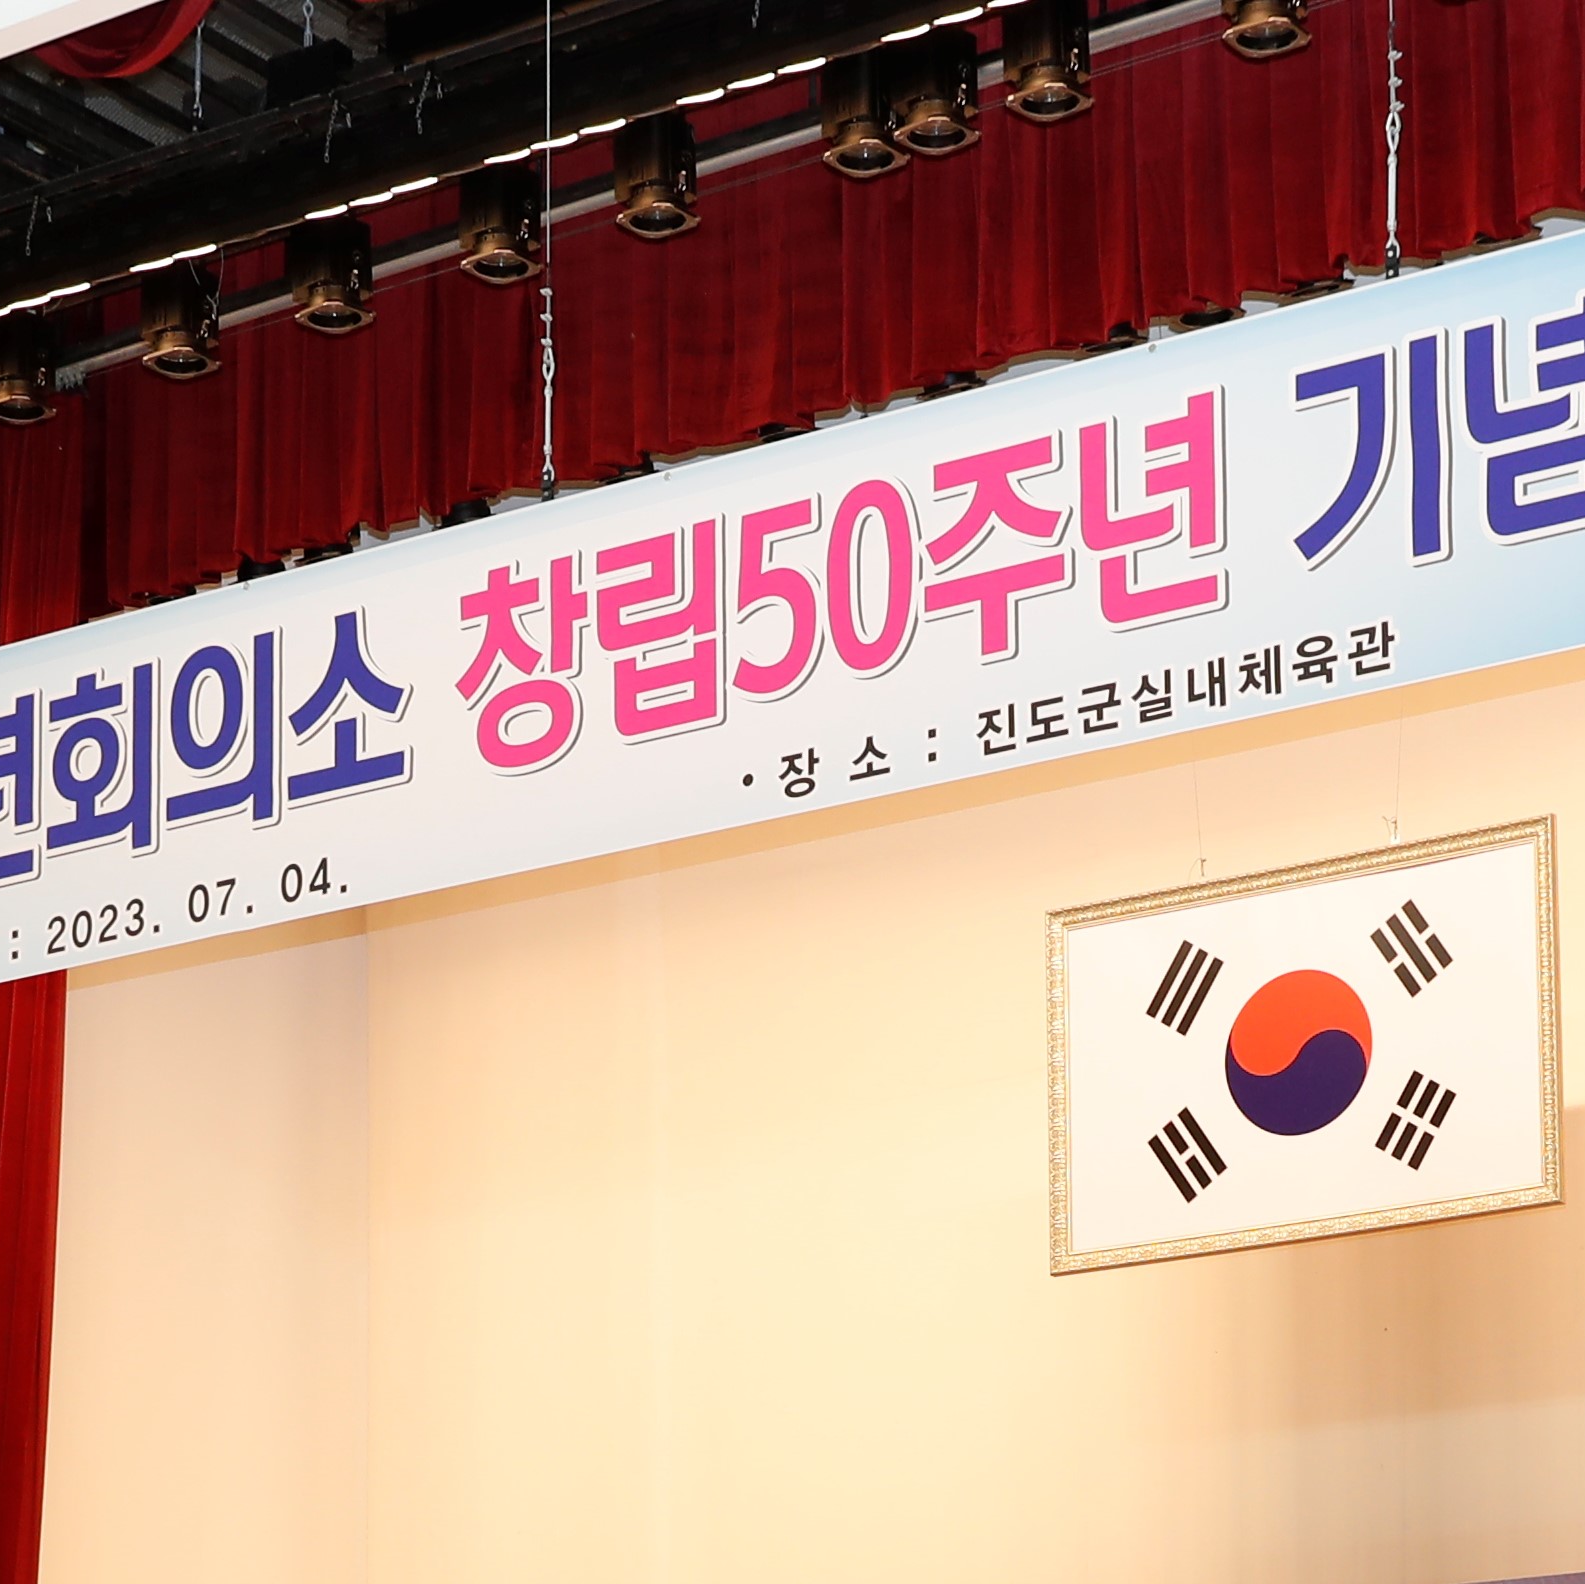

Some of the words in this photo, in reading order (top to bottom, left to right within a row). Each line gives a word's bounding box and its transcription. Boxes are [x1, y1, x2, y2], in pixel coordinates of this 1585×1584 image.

[455, 388, 1223, 771] 창립50주년
[976, 620, 1397, 757] 진도군실내체육관
[45, 897, 161, 957] 2023.
[187, 879, 255, 927] 07.
[280, 856, 349, 905] 04.
